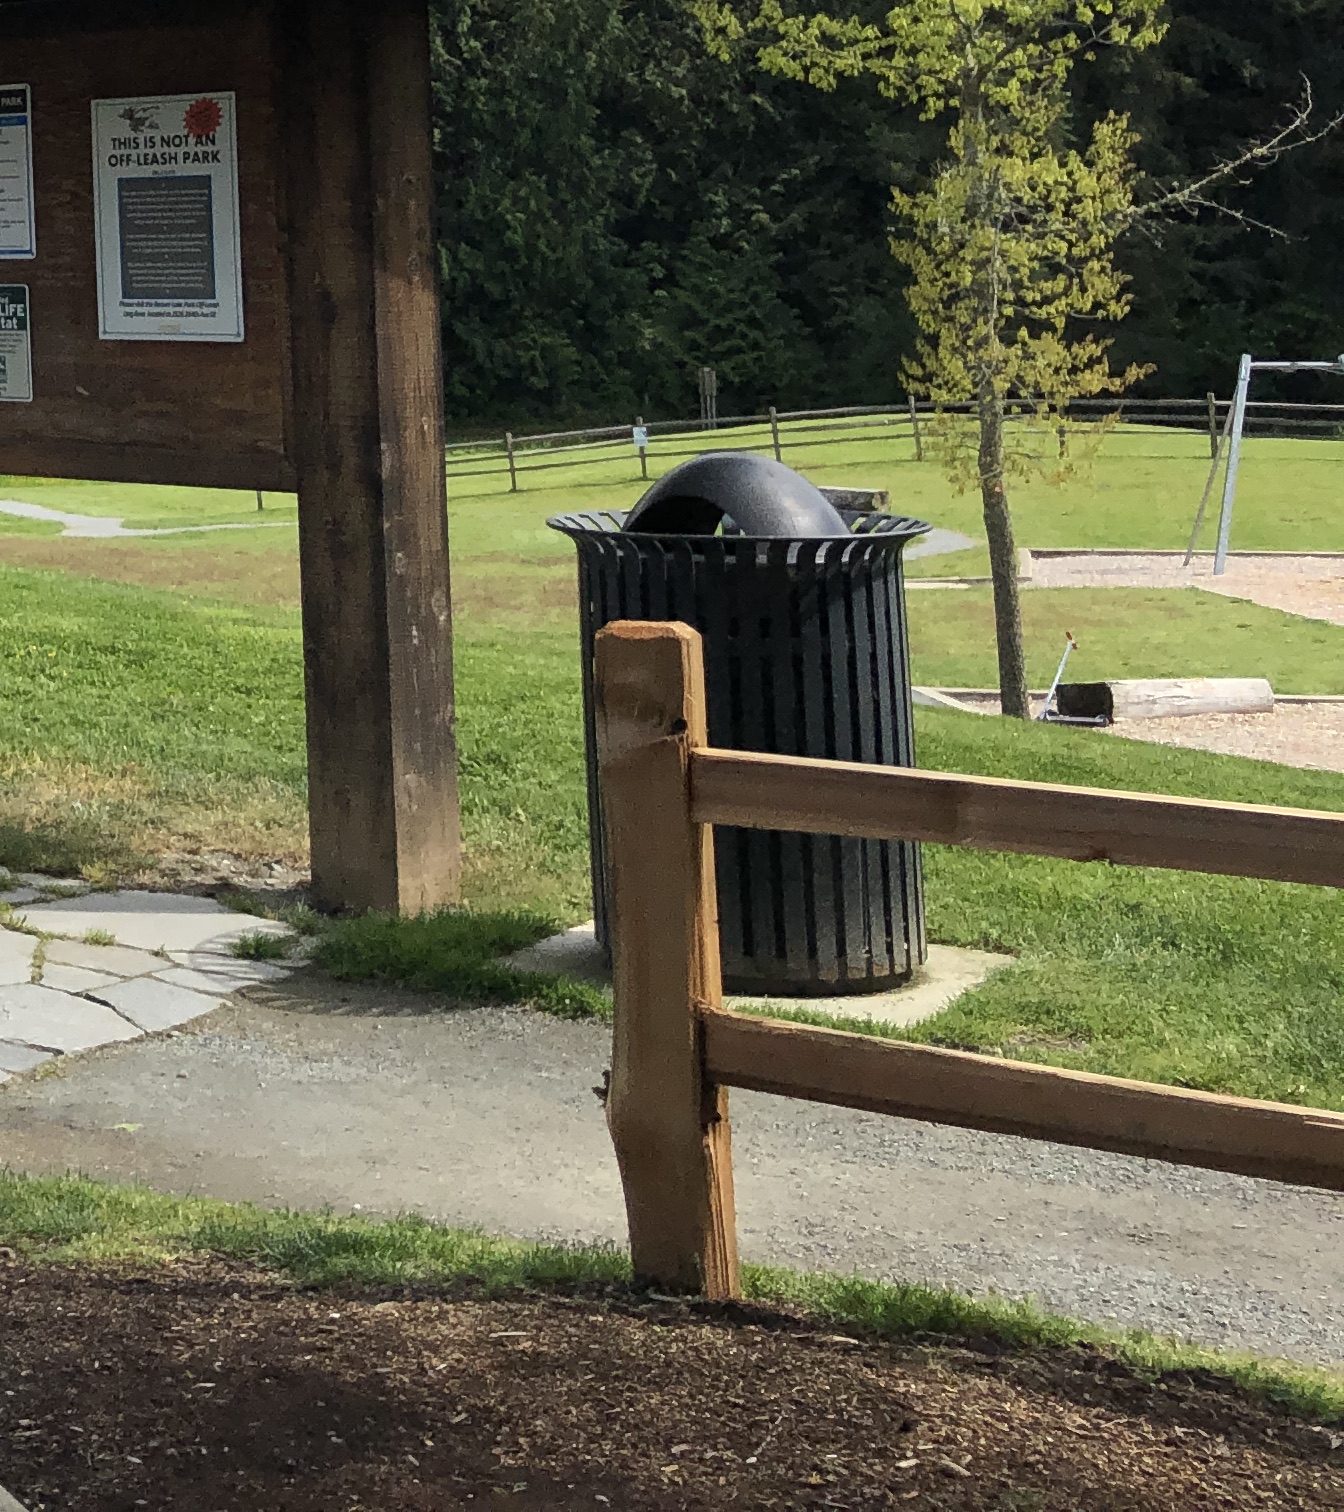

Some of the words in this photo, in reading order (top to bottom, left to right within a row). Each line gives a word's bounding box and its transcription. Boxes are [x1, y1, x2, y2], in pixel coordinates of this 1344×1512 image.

[1, 96, 23, 106] PARK
[111, 136, 139, 150] THIS
[144, 135, 156, 148] IS
[160, 134, 190, 148] NOT
[195, 133, 216, 147] AN
[108, 152, 178, 168] OFF-LEASH
[183, 150, 221, 164] PARK
